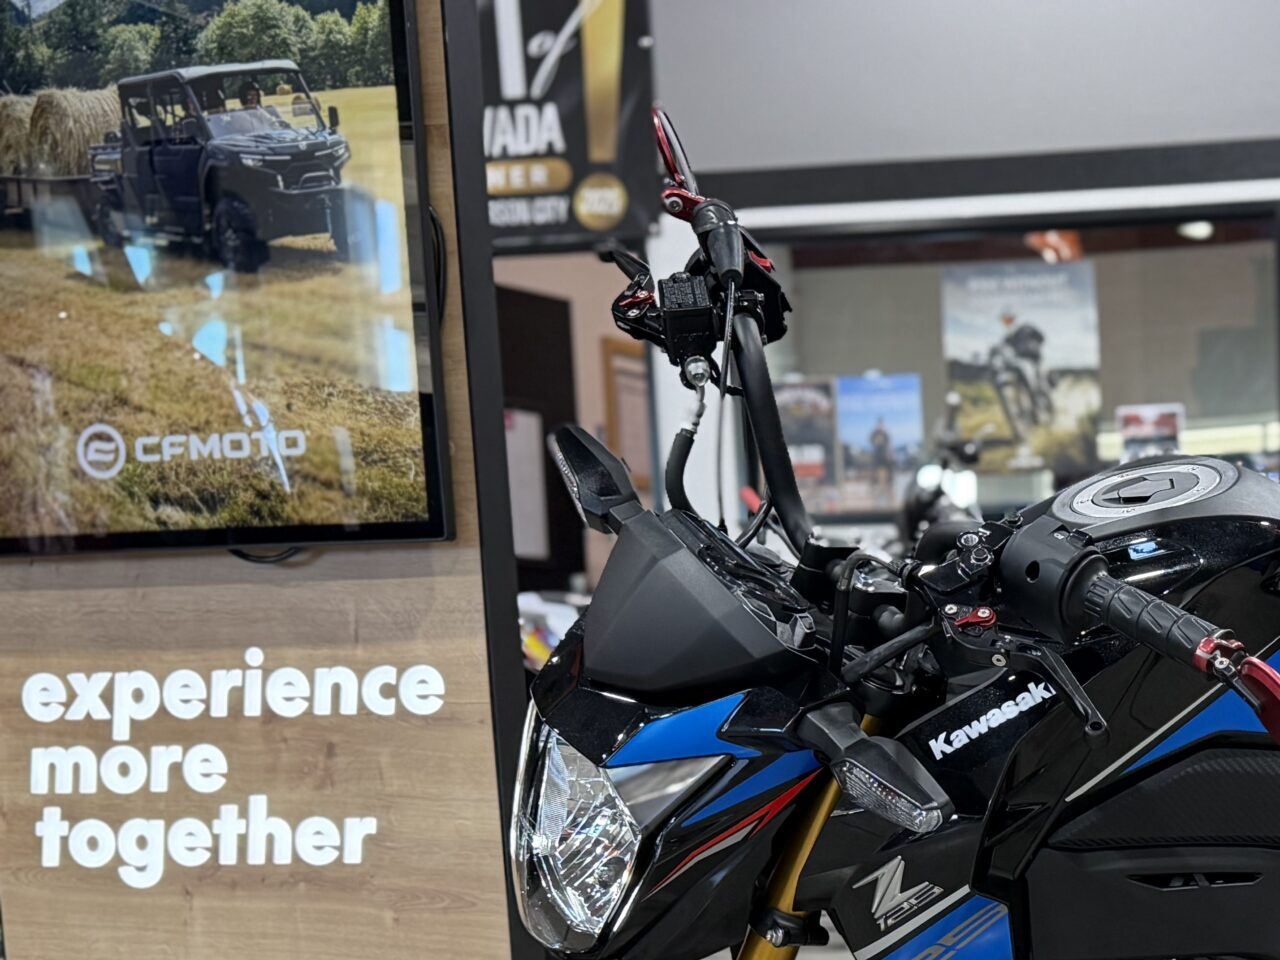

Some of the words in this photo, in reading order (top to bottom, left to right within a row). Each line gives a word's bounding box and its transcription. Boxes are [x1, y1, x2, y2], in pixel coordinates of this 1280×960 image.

[134, 429, 307, 463] CFMOTO
[21, 646, 446, 741] experience
[30, 743, 228, 795] more
[35, 794, 378, 889] together
